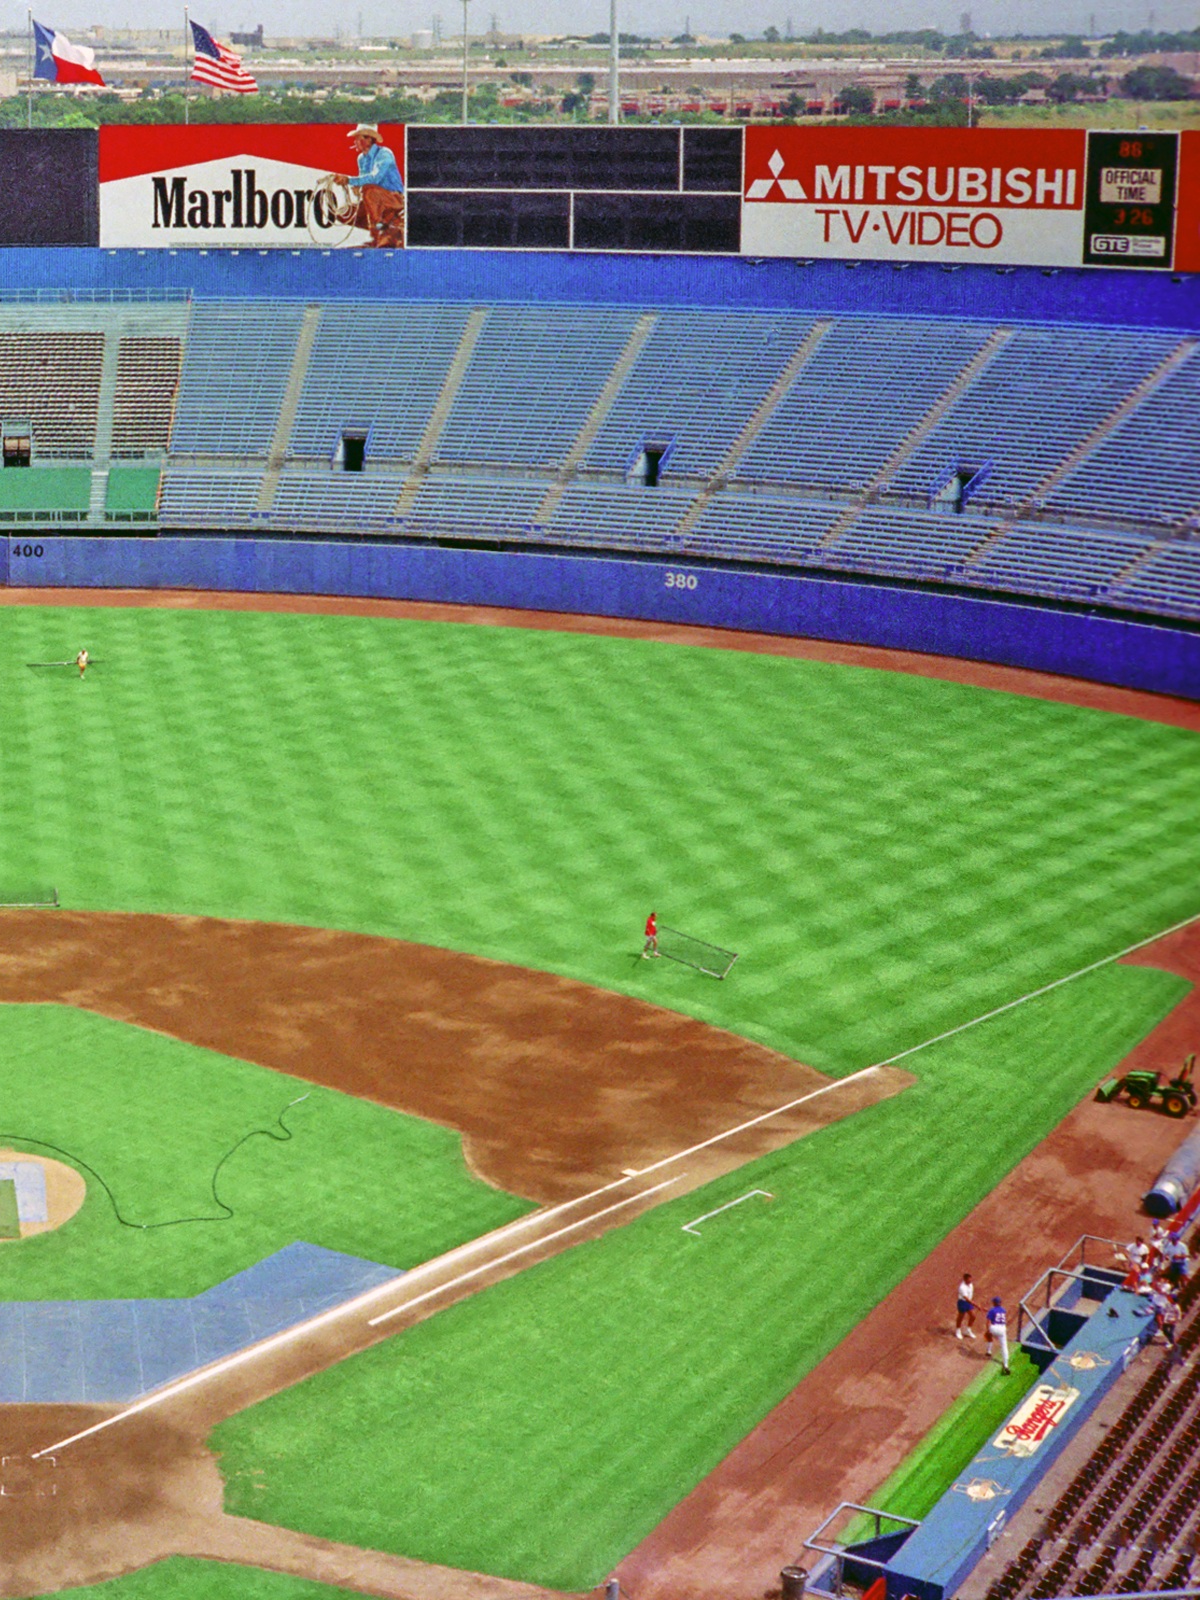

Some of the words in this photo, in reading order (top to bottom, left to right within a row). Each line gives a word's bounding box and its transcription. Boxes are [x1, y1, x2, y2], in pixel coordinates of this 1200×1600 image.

[814, 164, 1077, 205] MITSUBISHI
[1105, 170, 1157, 186] OFFICIAL
[152, 169, 338, 229] Marlboro
[1116, 186, 1146, 201] TIME
[1095, 237, 1128, 252] GTE
[12, 544, 44, 558] 400
[664, 571, 698, 590] 380
[1005, 1397, 1066, 1442] Rangers
